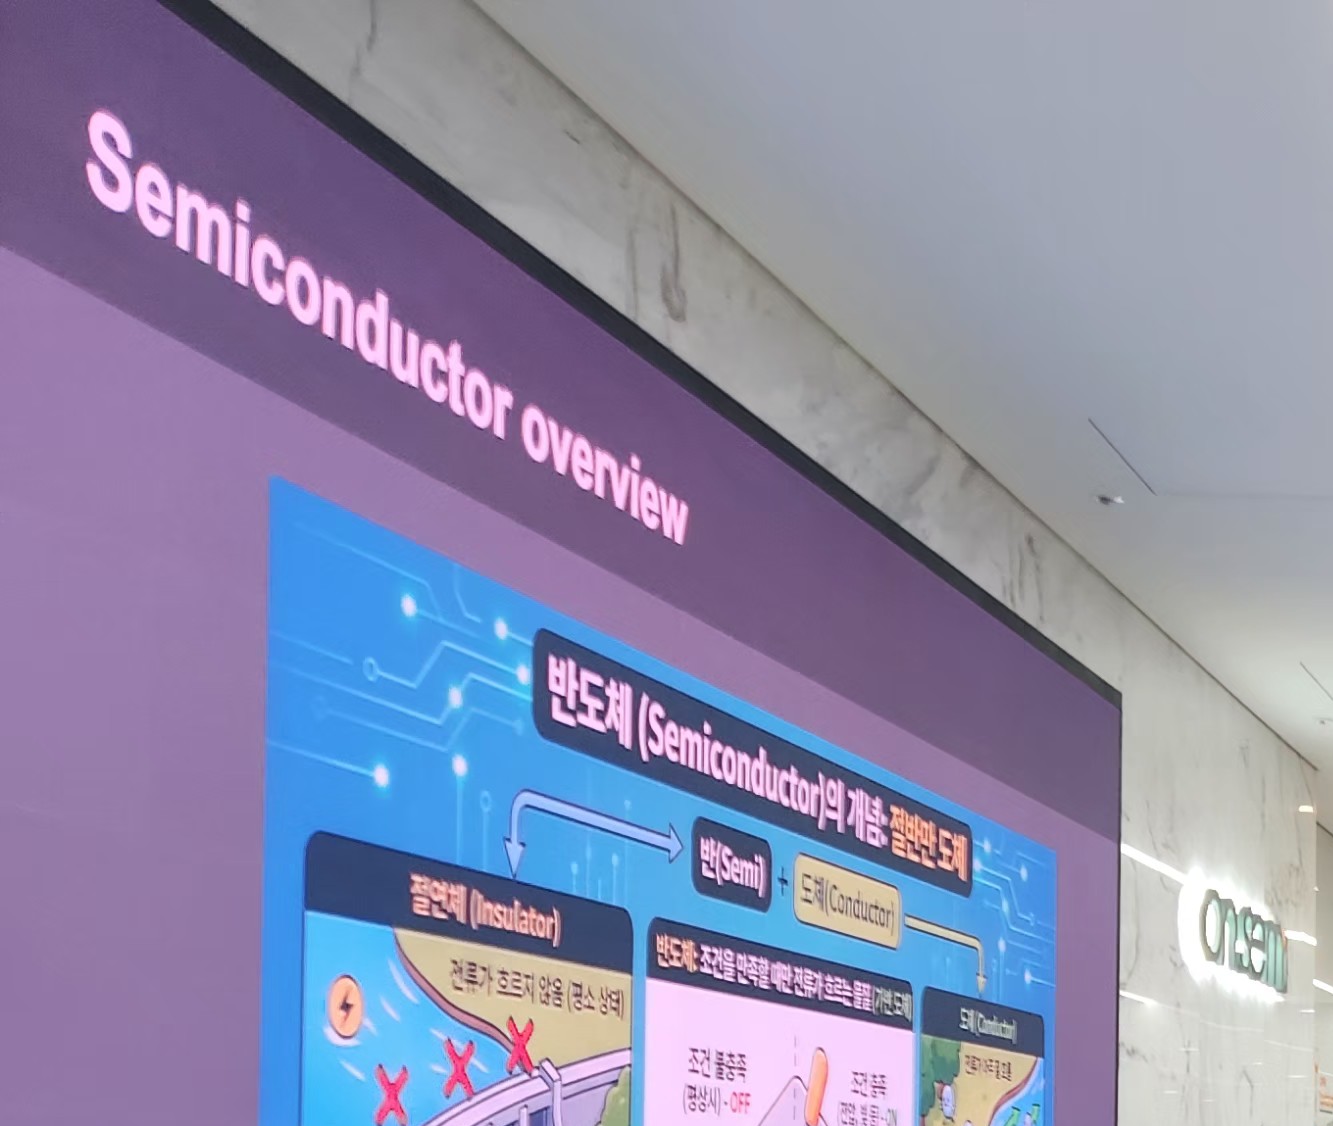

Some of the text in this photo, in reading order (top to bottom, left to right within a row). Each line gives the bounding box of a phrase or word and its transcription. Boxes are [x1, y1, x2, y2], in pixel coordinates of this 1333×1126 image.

[85, 107, 689, 546] Semiconductor overview
[547, 653, 634, 750] 반도체
[638, 691, 846, 835] (Semiconductor)의
[889, 804, 938, 869] 절반만
[937, 827, 968, 882] 도체
[409, 872, 561, 948] 절연체 (Insulator)
[700, 835, 768, 899] 반(Semi)
[800, 872, 895, 937] 도체(Conductor)
[450, 958, 493, 997] 전류가
[496, 968, 535, 1004] 흐르지
[538, 974, 563, 1008] 않음
[688, 1047, 711, 1078] 조건
[730, 1091, 751, 1114] OFF
